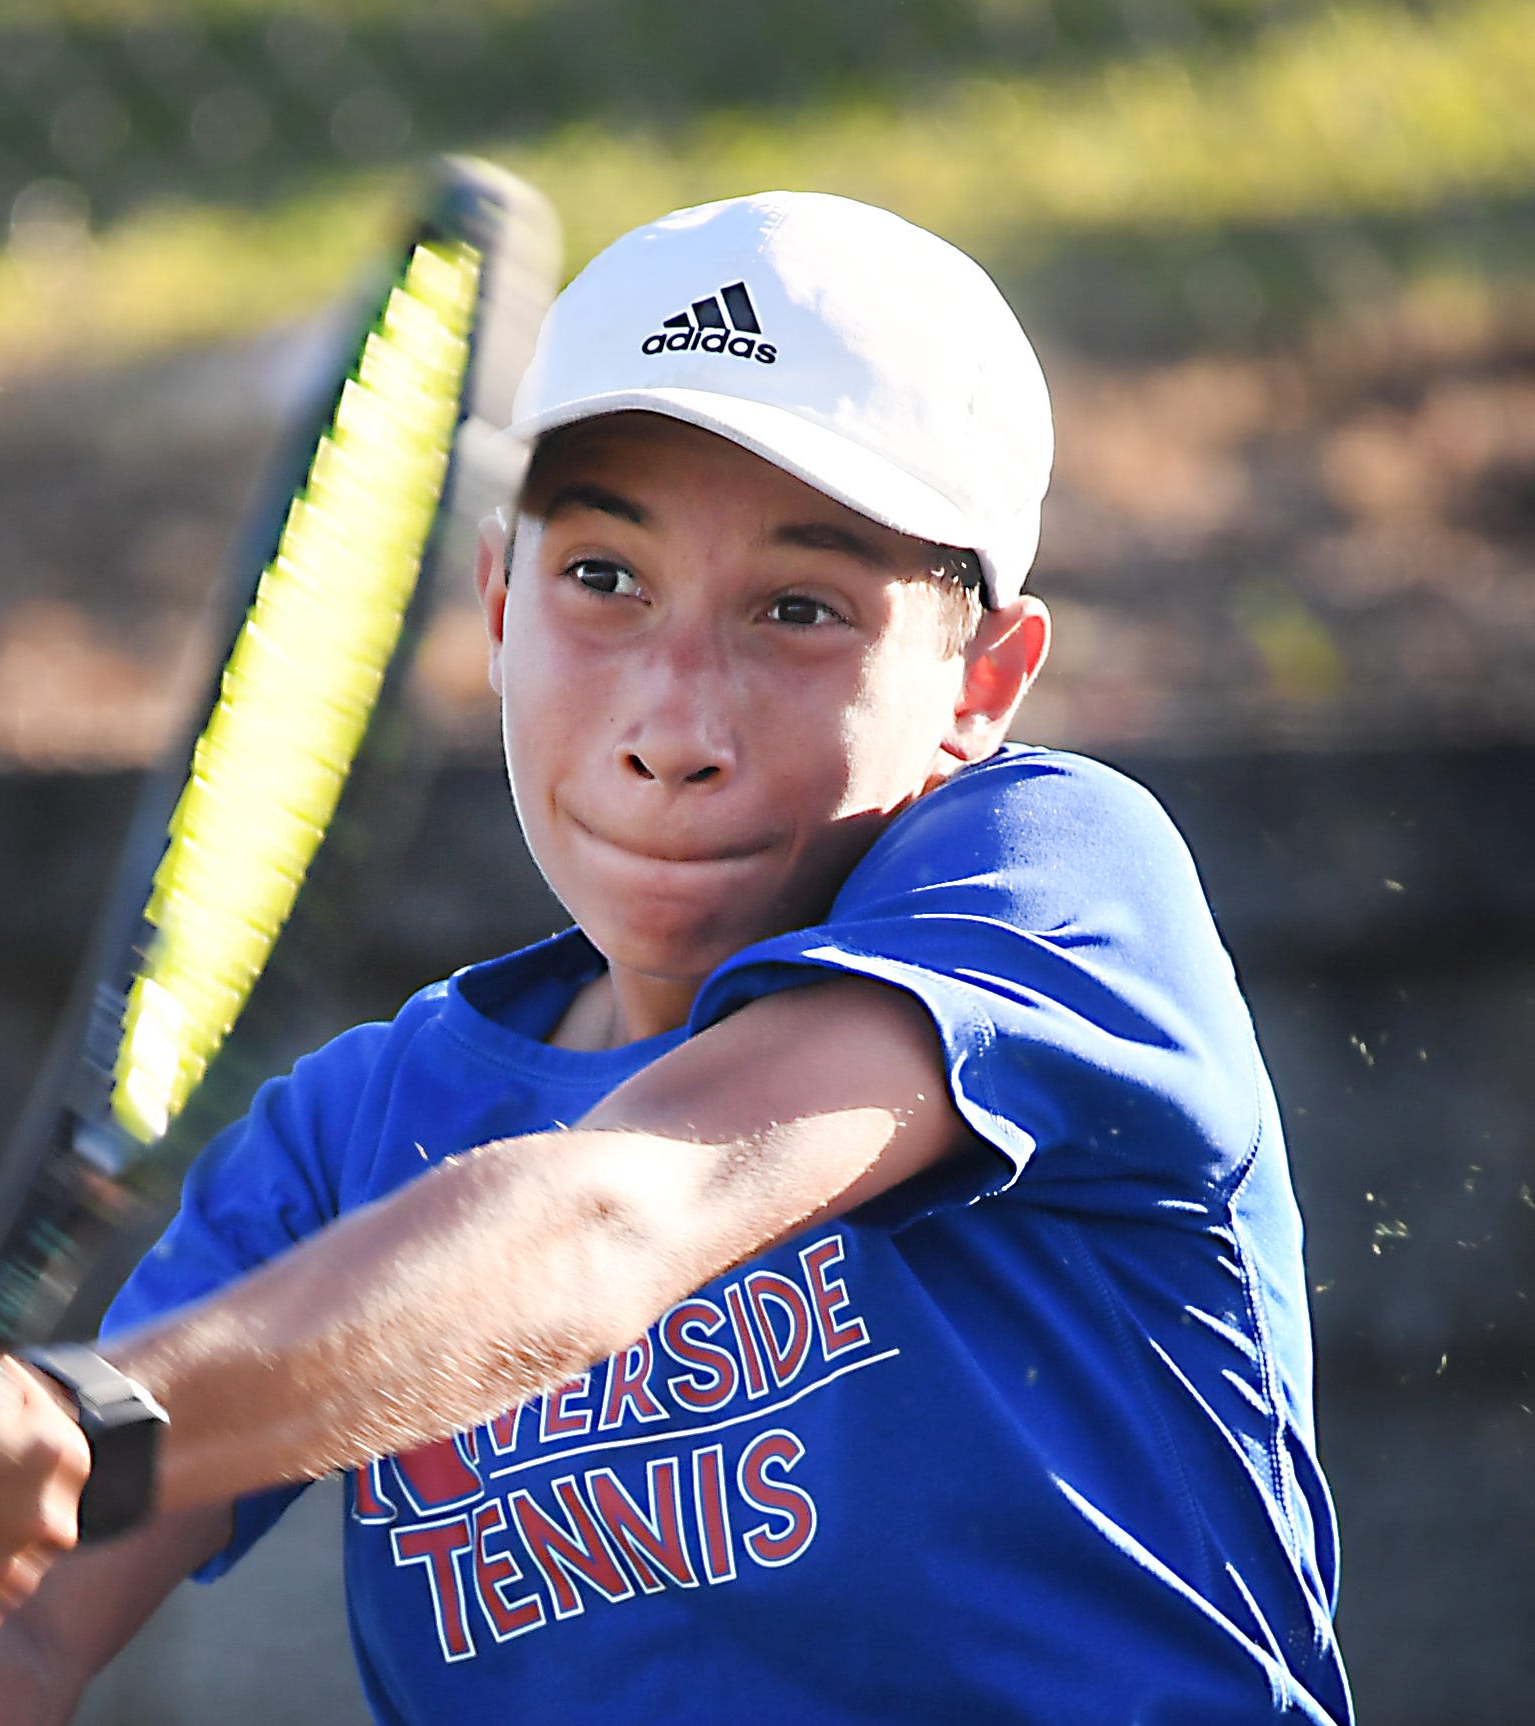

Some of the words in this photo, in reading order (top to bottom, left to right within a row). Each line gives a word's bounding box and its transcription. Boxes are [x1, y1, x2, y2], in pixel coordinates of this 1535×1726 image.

[642, 326, 777, 364] adidas
[352, 1235, 870, 1524] VERSIDE
[390, 1428, 817, 1662] TENNIS
